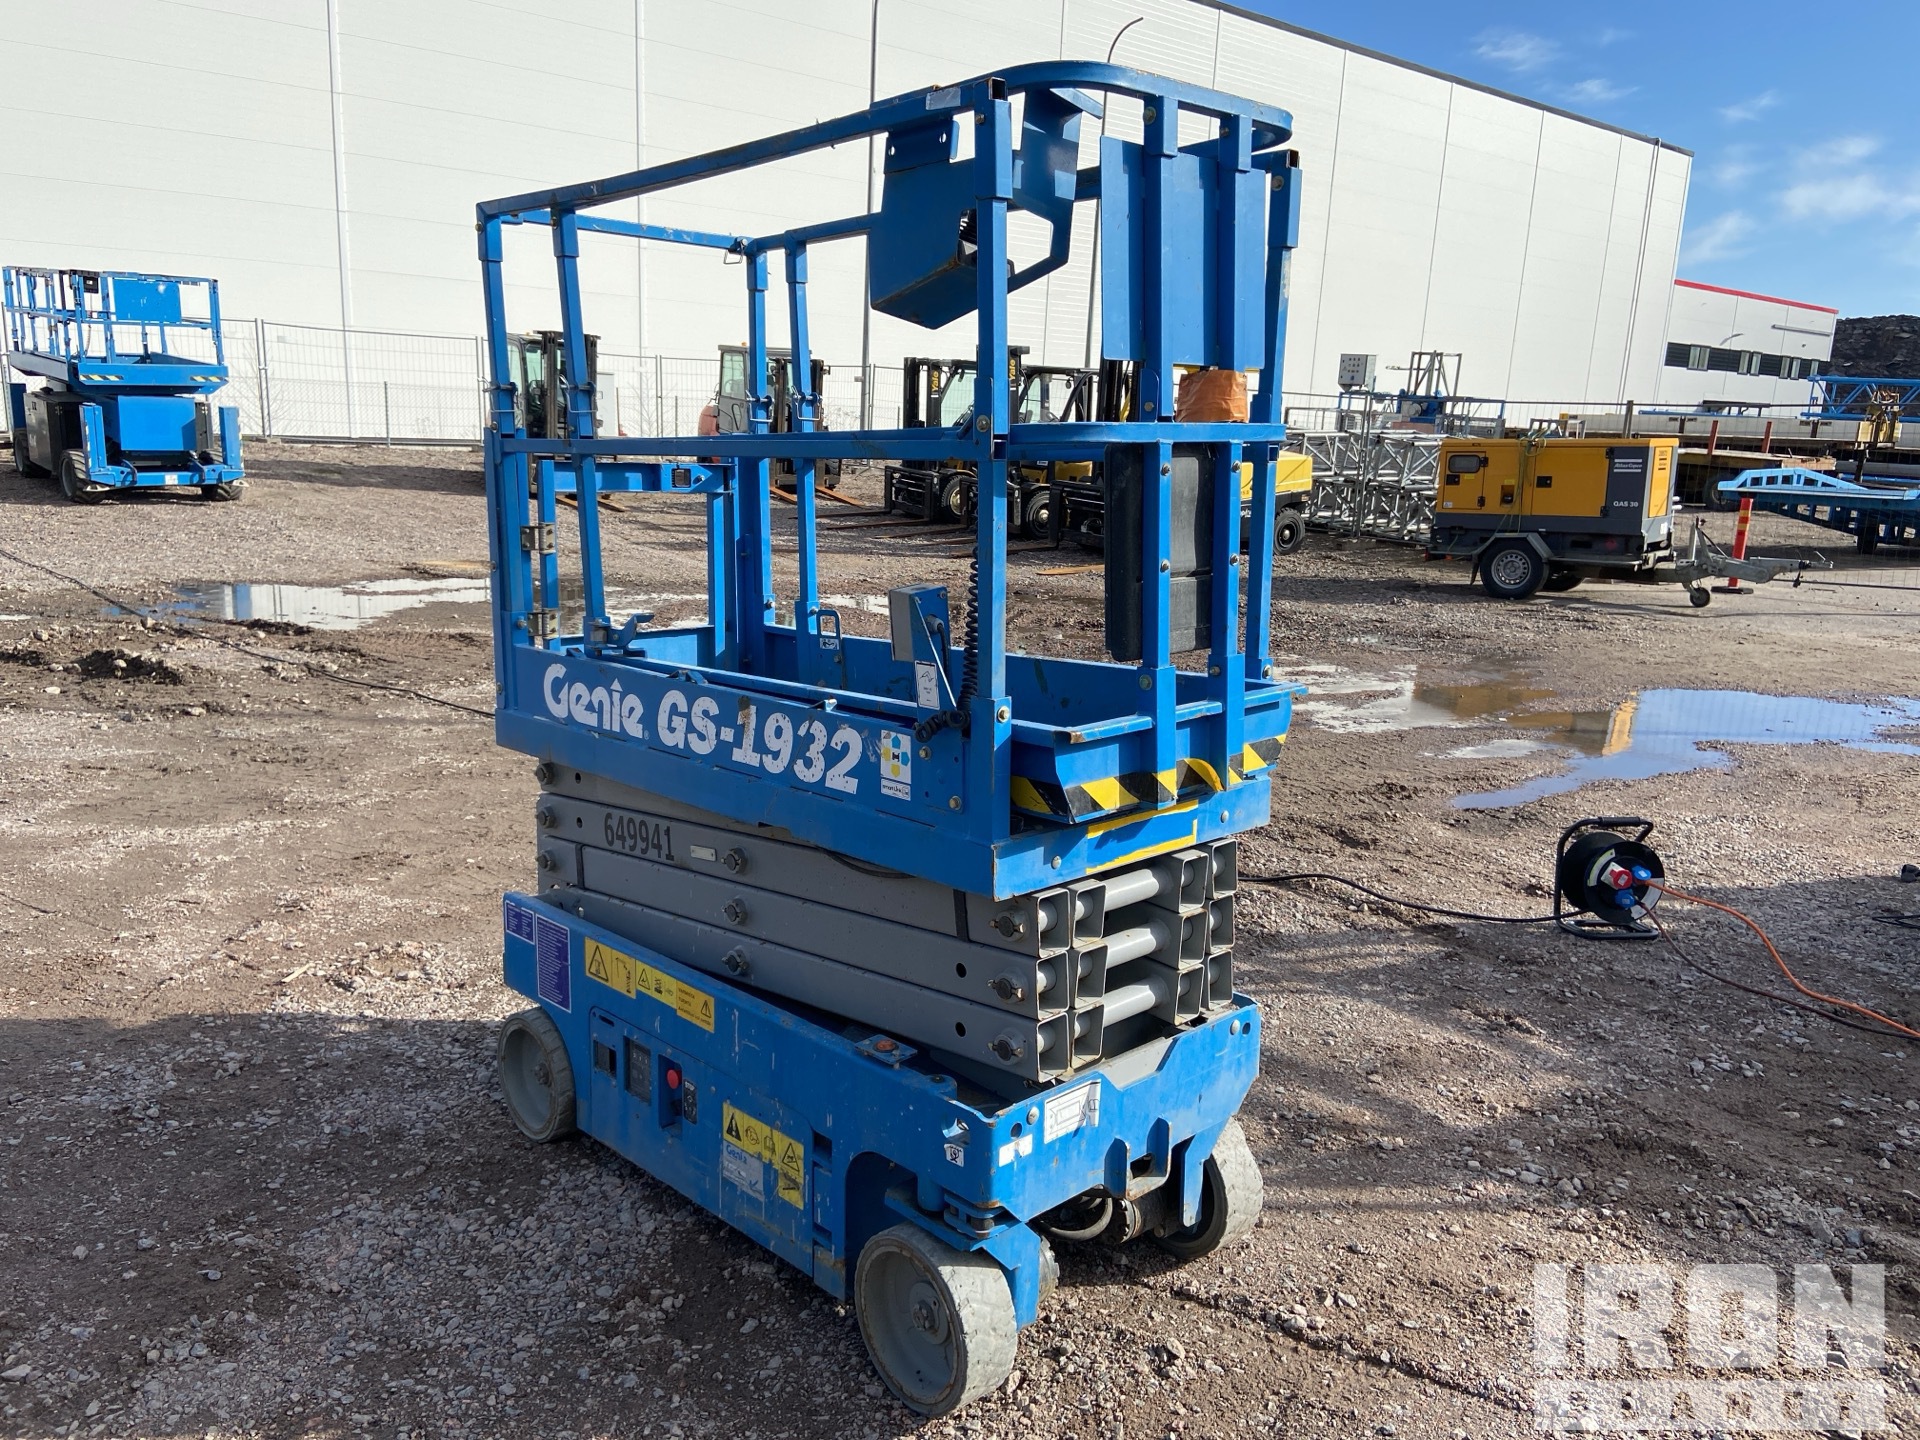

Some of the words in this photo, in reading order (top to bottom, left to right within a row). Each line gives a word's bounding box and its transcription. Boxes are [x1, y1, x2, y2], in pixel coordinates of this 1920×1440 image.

[930, 370, 939, 392] Yale
[1008, 359, 1016, 381] Yale
[542, 662, 645, 740] Genie
[657, 689, 863, 795] GS-1932
[604, 812, 675, 862] 649941
